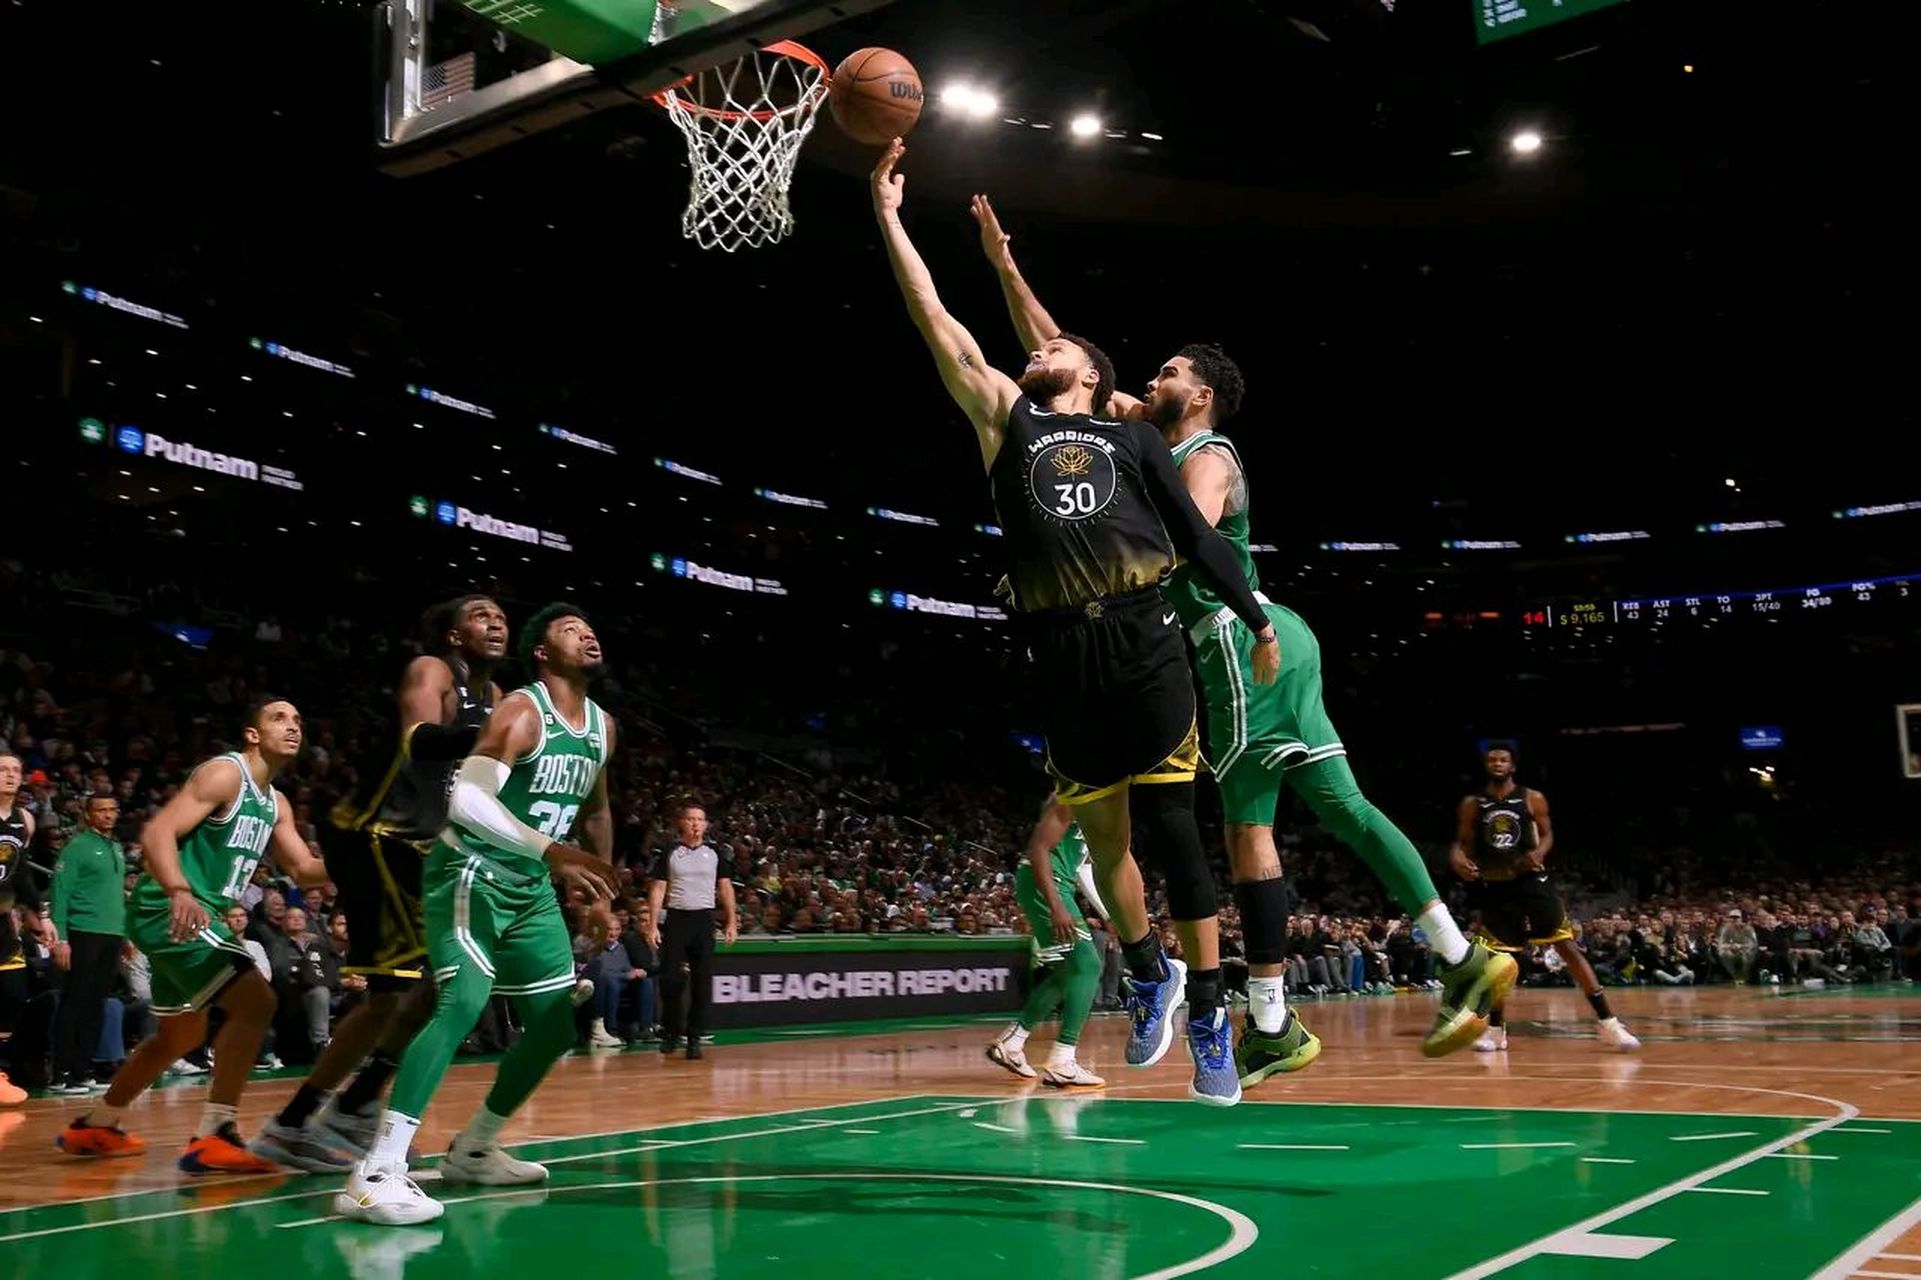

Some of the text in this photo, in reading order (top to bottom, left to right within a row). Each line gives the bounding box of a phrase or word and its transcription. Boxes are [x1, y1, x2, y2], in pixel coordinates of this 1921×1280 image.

[1028, 430, 1116, 453] WARRIORS
[144, 432, 259, 481] Putnam
[1054, 482, 1096, 515] 30
[456, 506, 540, 545] Putnam
[686, 561, 753, 592] Putnam
[906, 593, 976, 619] Putnam
[1653, 600, 1670, 608] AST
[1716, 596, 1730, 604] TO
[1755, 593, 1772, 601] 3PT
[1657, 609, 1669, 617] 24
[1752, 601, 1781, 612] 15/40
[1570, 611, 1606, 625] 9,165
[1493, 833, 1513, 849] 22
[712, 968, 1010, 1003] BLEACHER REPORT
